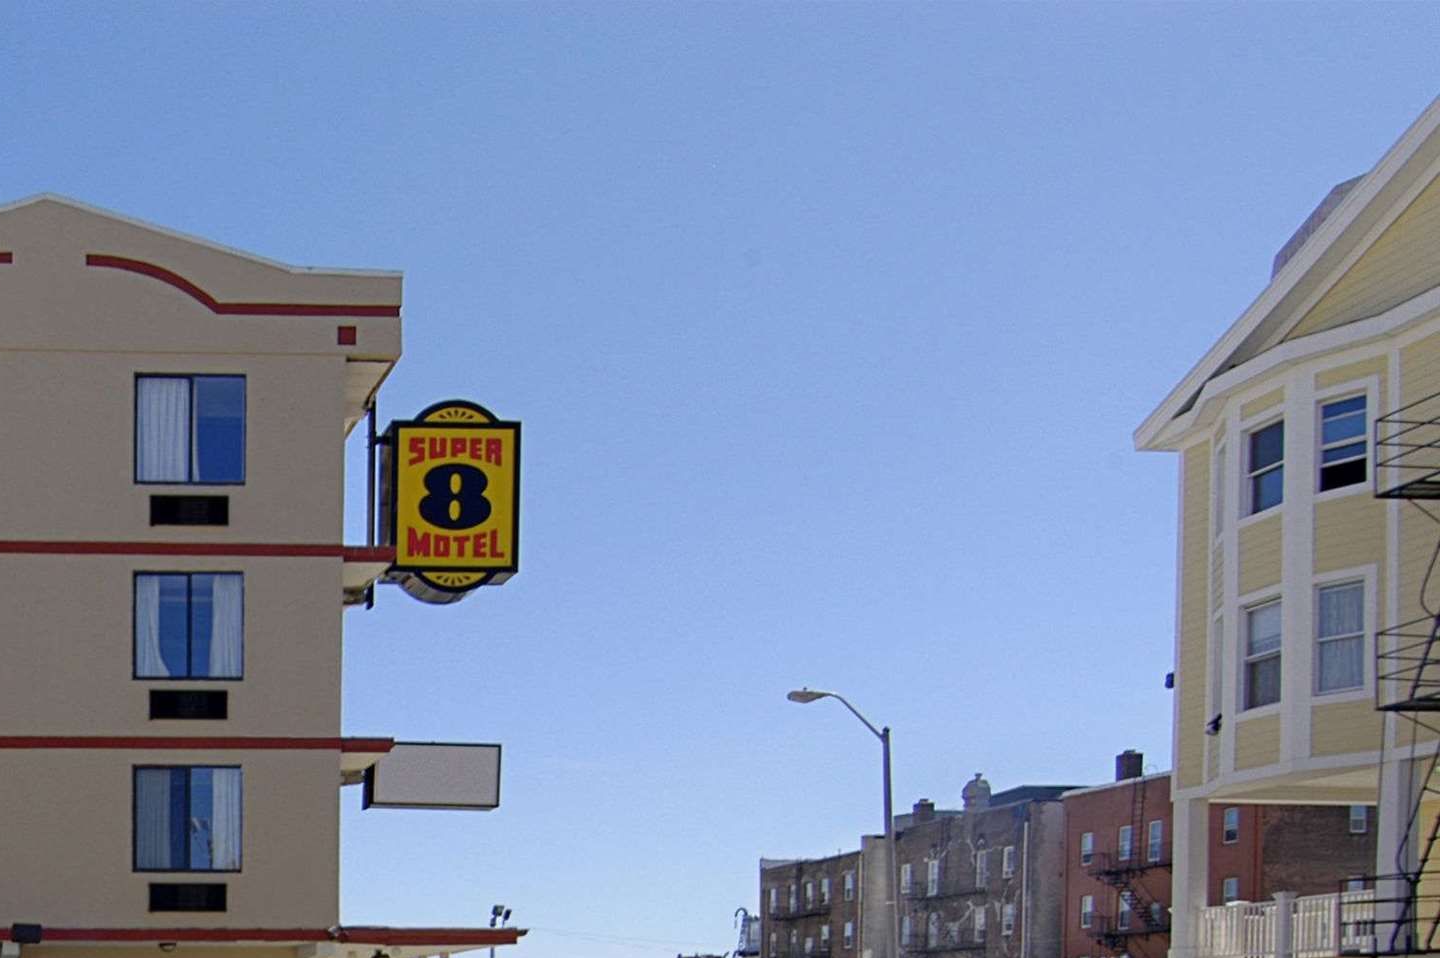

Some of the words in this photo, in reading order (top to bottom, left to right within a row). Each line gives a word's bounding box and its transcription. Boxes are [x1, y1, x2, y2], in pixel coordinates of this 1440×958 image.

[408, 437, 502, 466] SUPER
[418, 463, 491, 530] 8
[407, 527, 505, 558] MOTEL
